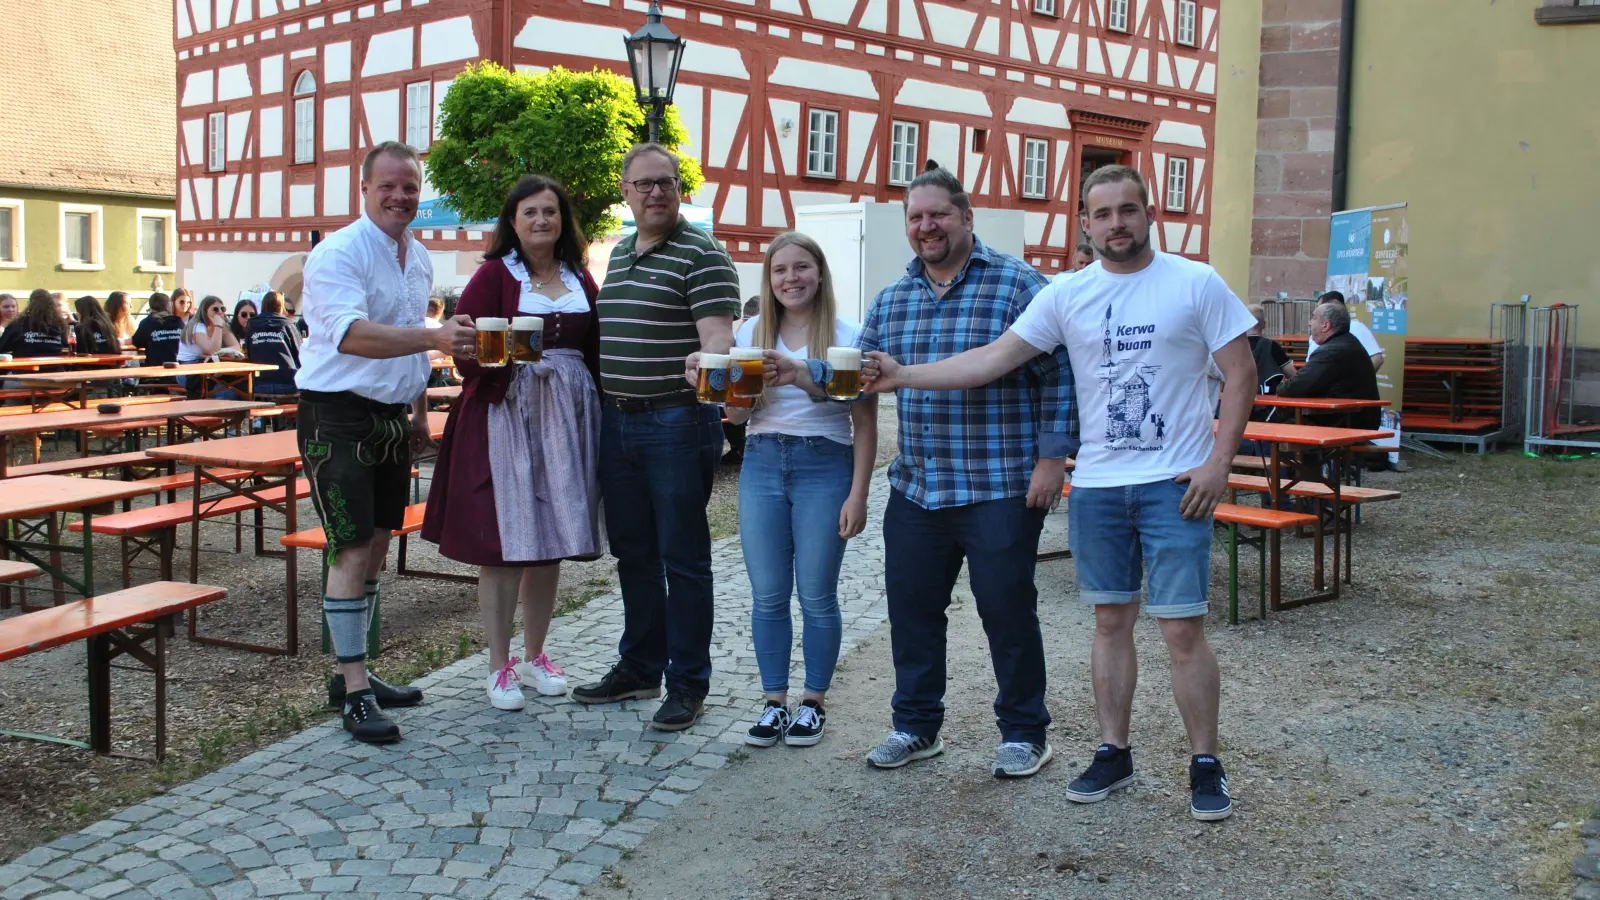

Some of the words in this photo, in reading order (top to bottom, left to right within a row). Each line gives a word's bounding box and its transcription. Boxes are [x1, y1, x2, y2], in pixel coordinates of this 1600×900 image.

[1095, 136, 1123, 146] MUSEUM
[415, 208, 433, 219] NER
[1116, 324, 1155, 337] Kerwa
[1117, 340, 1152, 351] buam
